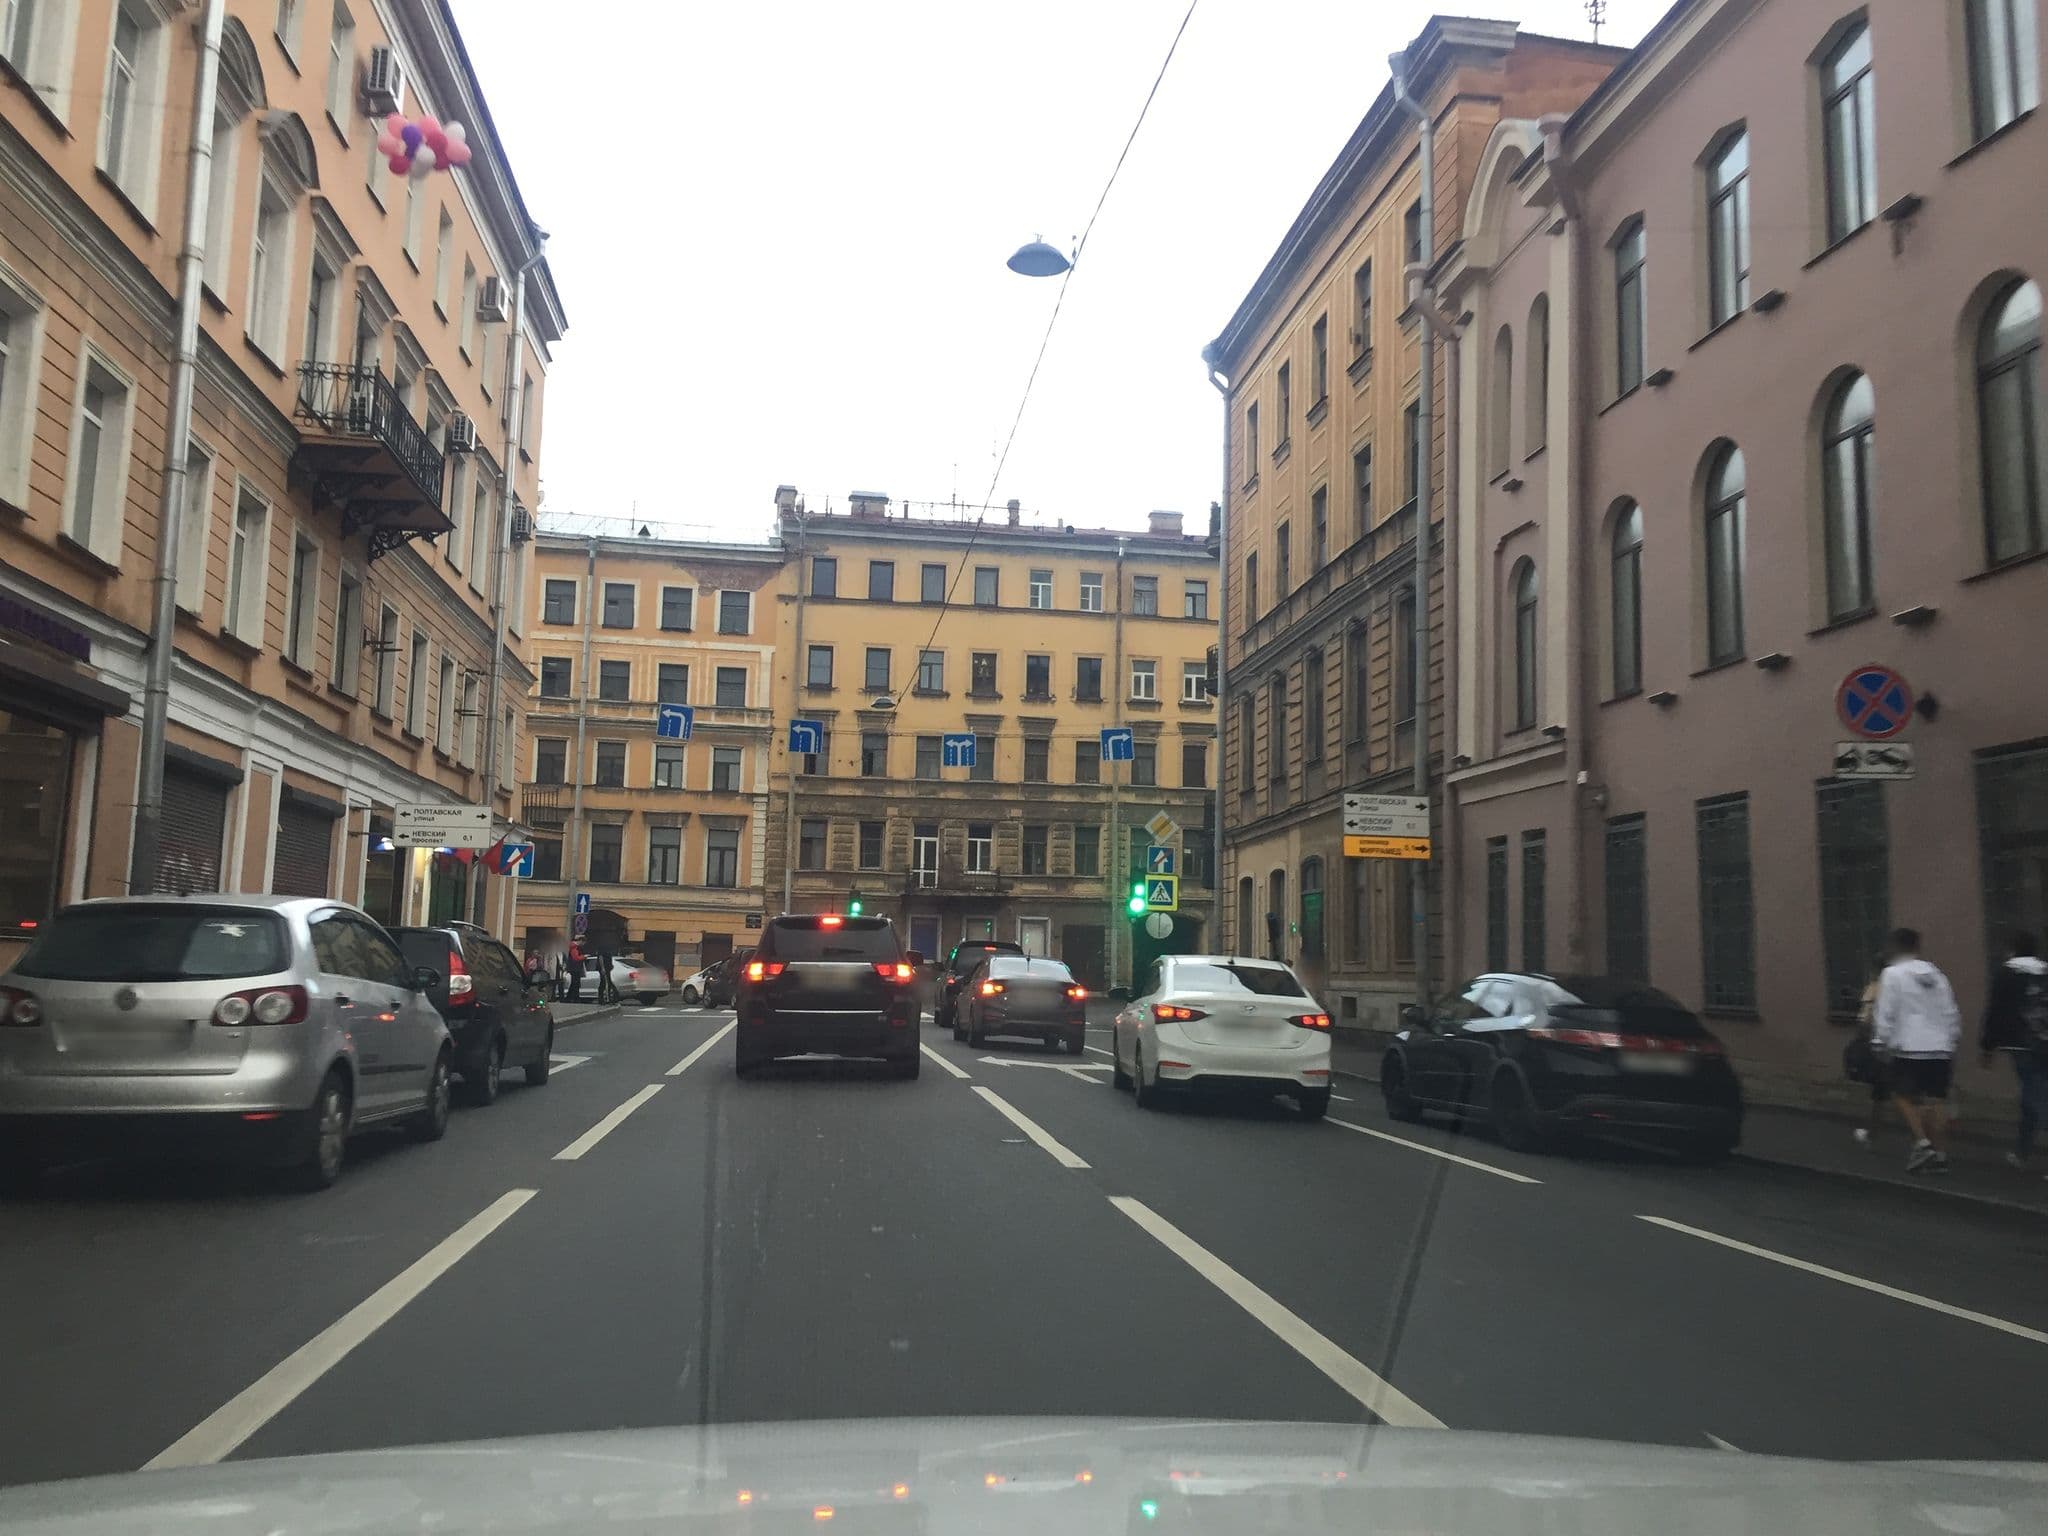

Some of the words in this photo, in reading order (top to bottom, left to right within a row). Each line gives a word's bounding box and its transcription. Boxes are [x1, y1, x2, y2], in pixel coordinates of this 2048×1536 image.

[413, 808, 462, 816] ПОЛТАВСКАЯ
[412, 830, 446, 838] НЕВСКИЙ
[462, 834, 473, 842] 0,1
